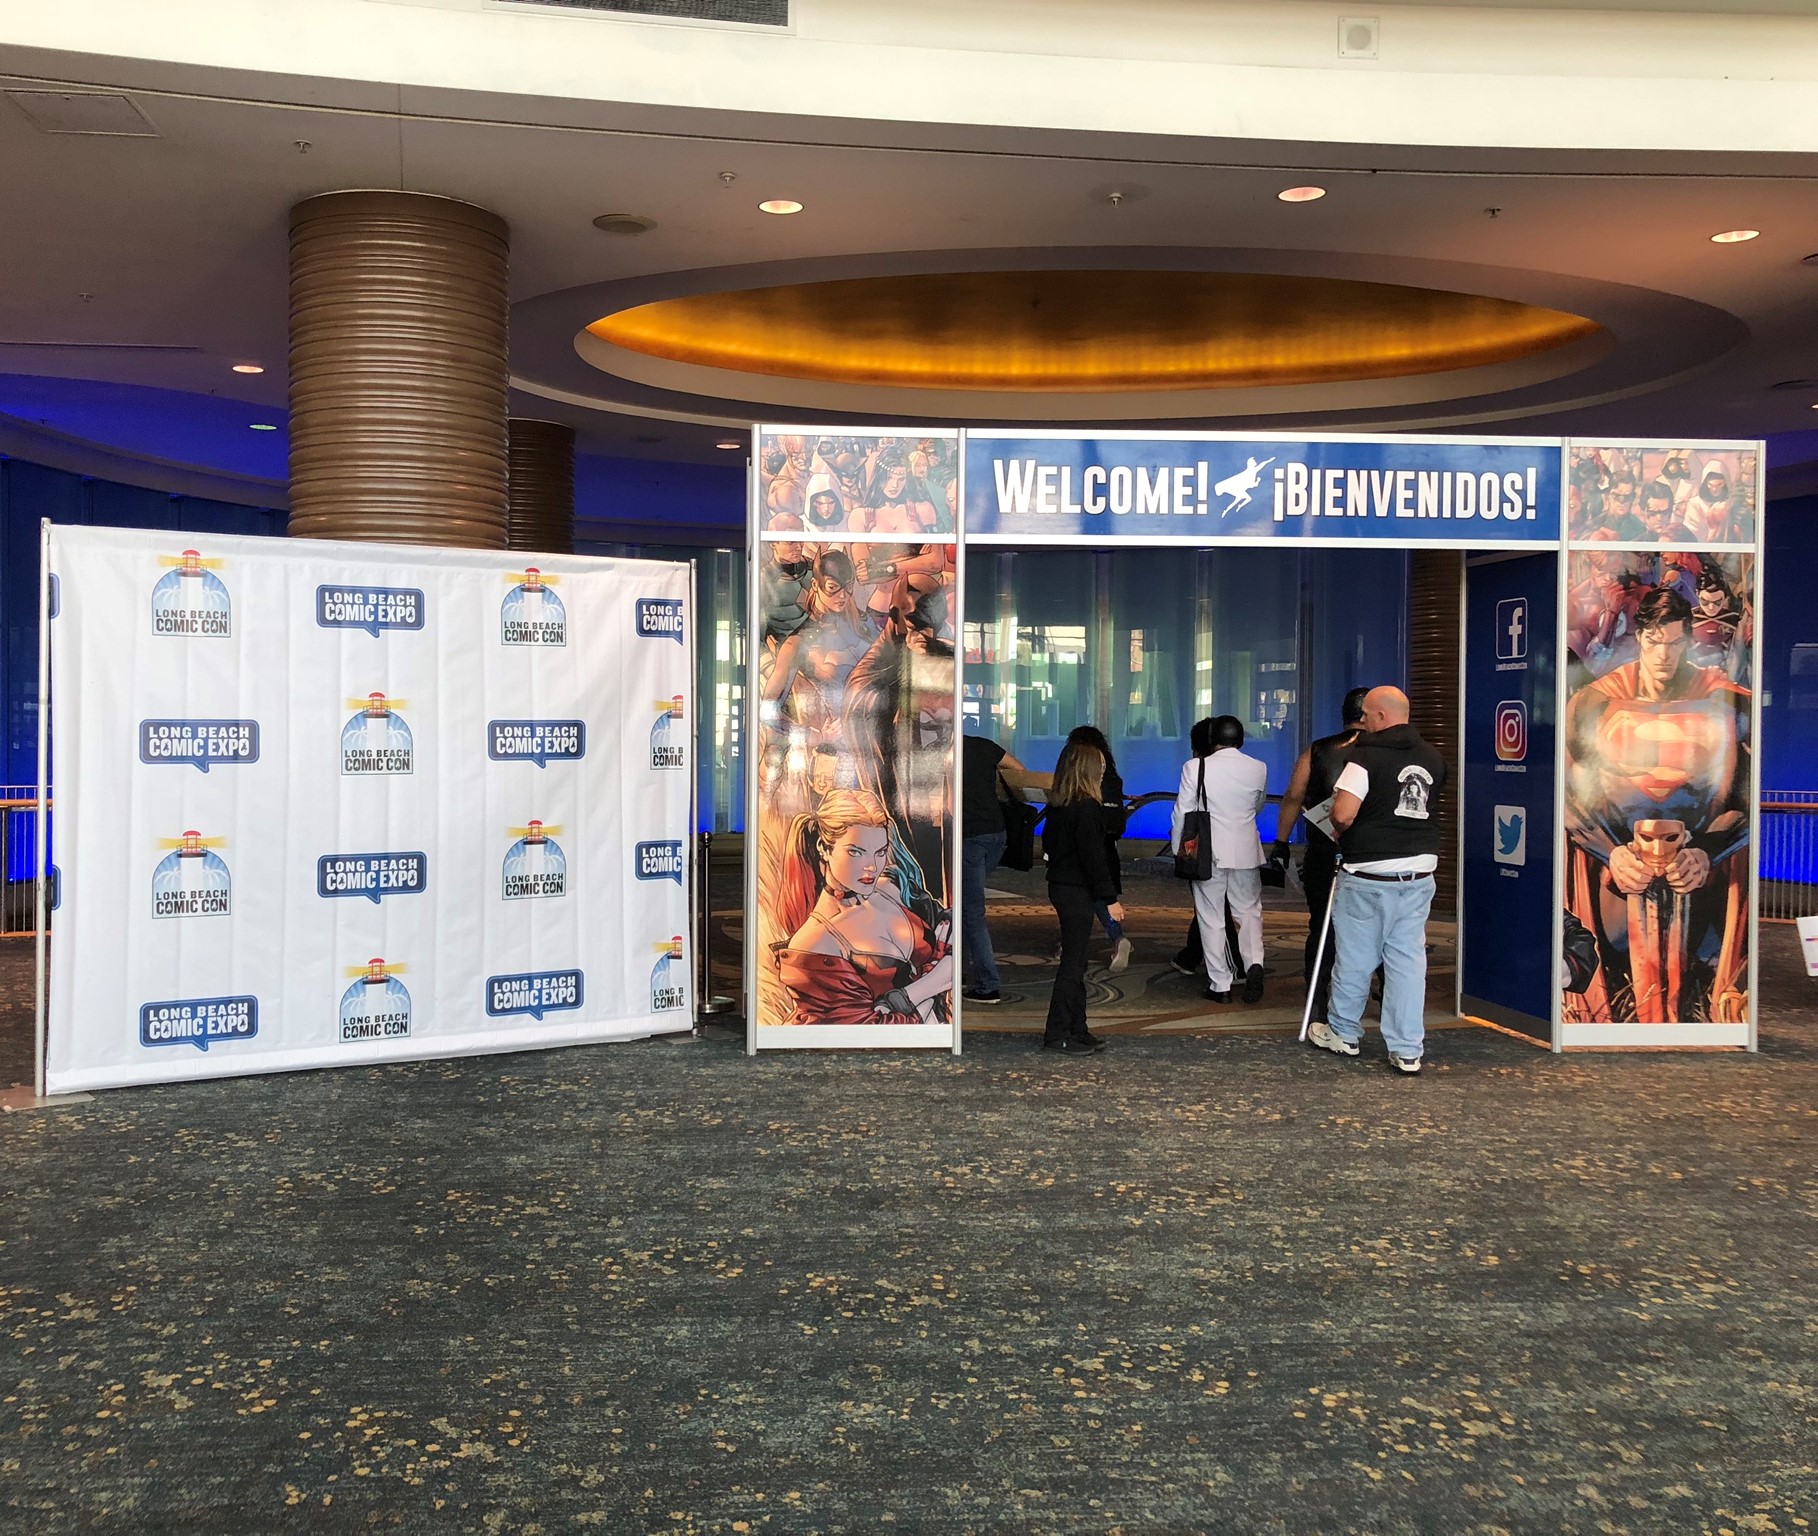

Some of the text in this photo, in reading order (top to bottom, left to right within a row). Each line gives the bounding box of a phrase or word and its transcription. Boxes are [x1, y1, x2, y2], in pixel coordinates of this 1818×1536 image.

[992, 459, 1537, 522] WELCOME! ¡BIENVENIDOS!
[325, 591, 415, 606] LONG BEACH
[156, 609, 228, 620] LONG BEACH
[325, 604, 415, 623] COMIC EXPO
[642, 605, 673, 615] LONG
[156, 619, 228, 634] COMIC CON
[504, 621, 564, 631] LONG BEACH
[642, 615, 683, 631] COMIC
[504, 629, 564, 643] COMIC CON
[149, 727, 249, 738] LONG BEACH
[496, 726, 578, 737] LONG BEACH
[149, 738, 249, 757] COMIC EXPO
[496, 737, 578, 753] COMIC EXPO
[344, 750, 373, 758] LONG
[653, 754, 684, 767] COMIC
[344, 758, 410, 771] COMIC CON
[642, 847, 672, 857] LONG
[326, 859, 417, 873] LONG BEACH
[642, 857, 682, 874] COMIC
[326, 869, 417, 891] COMIC EXPO
[506, 873, 564, 883] LONG BEACH
[156, 889, 228, 900] LONG BEACH
[506, 881, 564, 896] COMIC CON
[156, 898, 228, 915] COMIC CON
[494, 976, 576, 992] LONG BEACH
[494, 986, 576, 1009] COMIC EXPO
[653, 987, 675, 996] LONG
[654, 995, 684, 1009] COMIC
[149, 1003, 248, 1020] LONG BEACH
[149, 1014, 248, 1039] COMIC EXPO
[343, 1013, 408, 1026] LONG BEACH
[343, 1021, 408, 1039] COMIC CON
